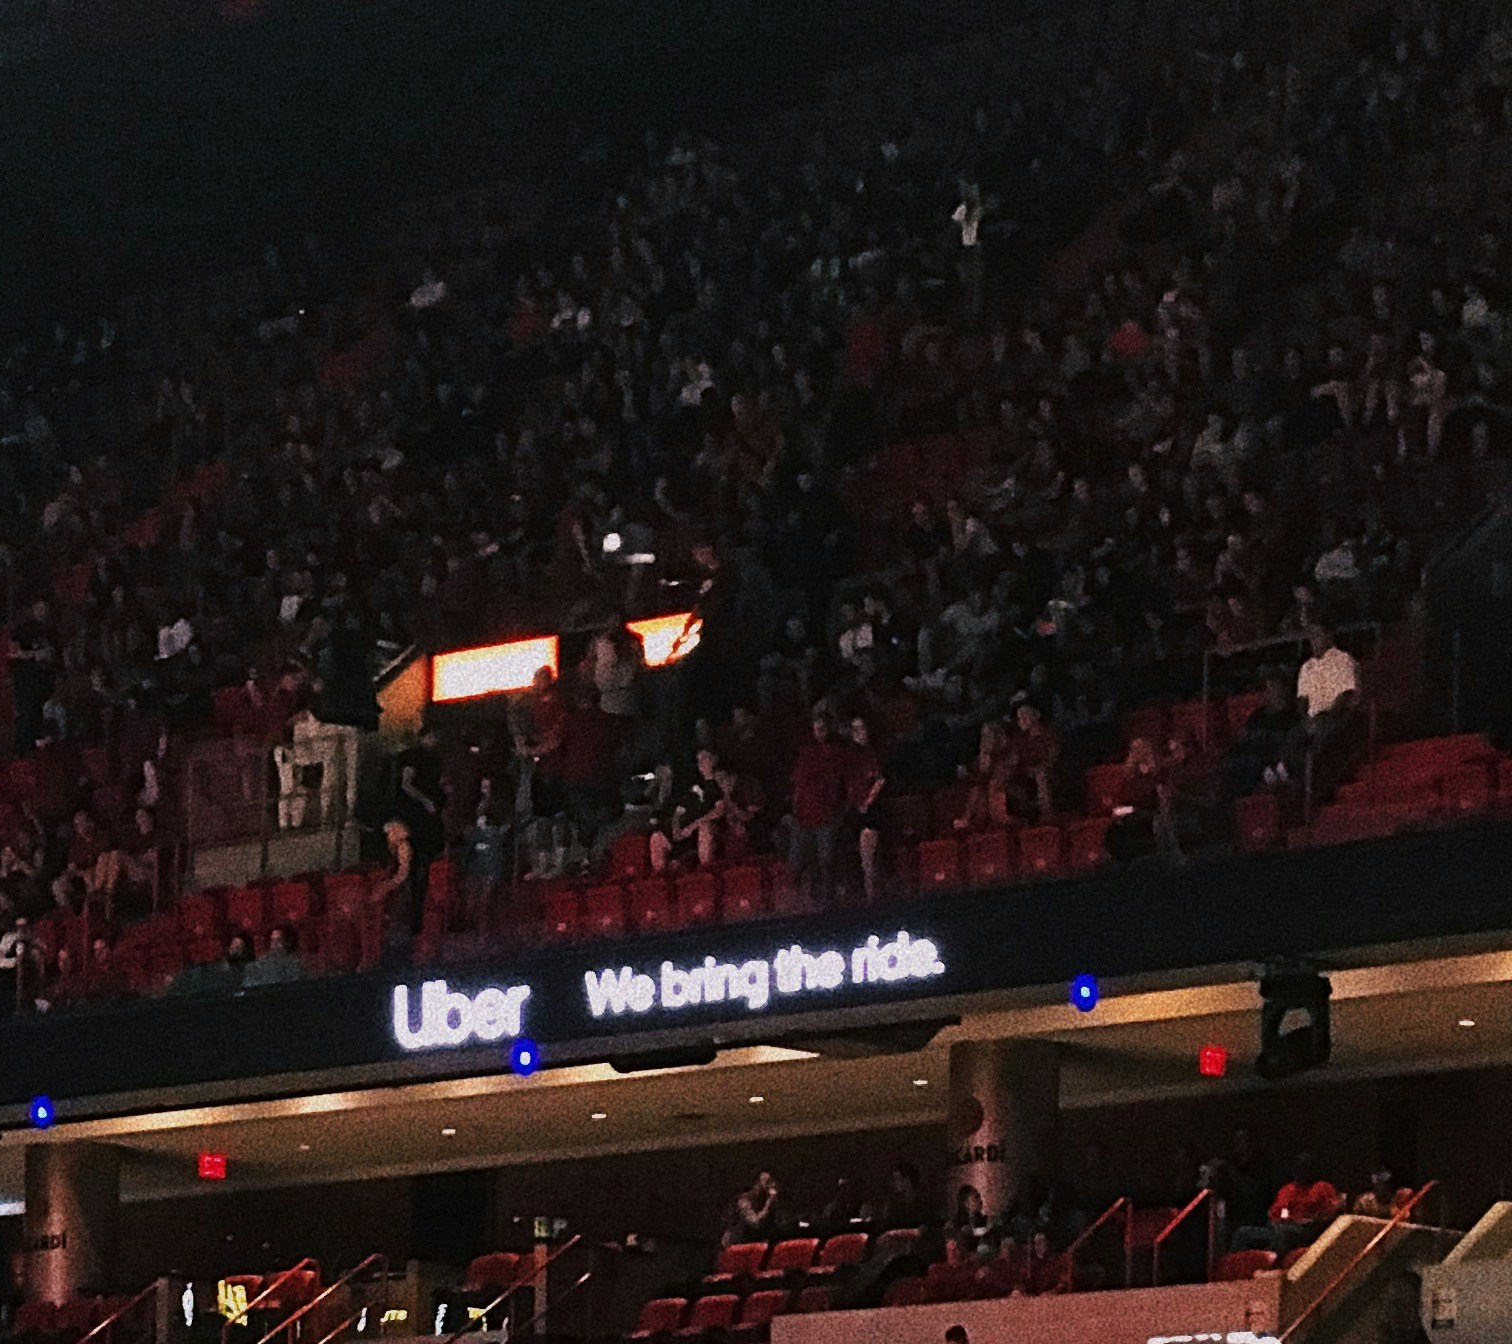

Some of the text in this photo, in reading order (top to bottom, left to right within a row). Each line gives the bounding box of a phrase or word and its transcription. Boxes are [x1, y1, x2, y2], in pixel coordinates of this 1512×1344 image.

[393, 979, 531, 1050] Uber
[584, 965, 656, 1018] We
[660, 956, 770, 1011] bring
[772, 945, 846, 995] the
